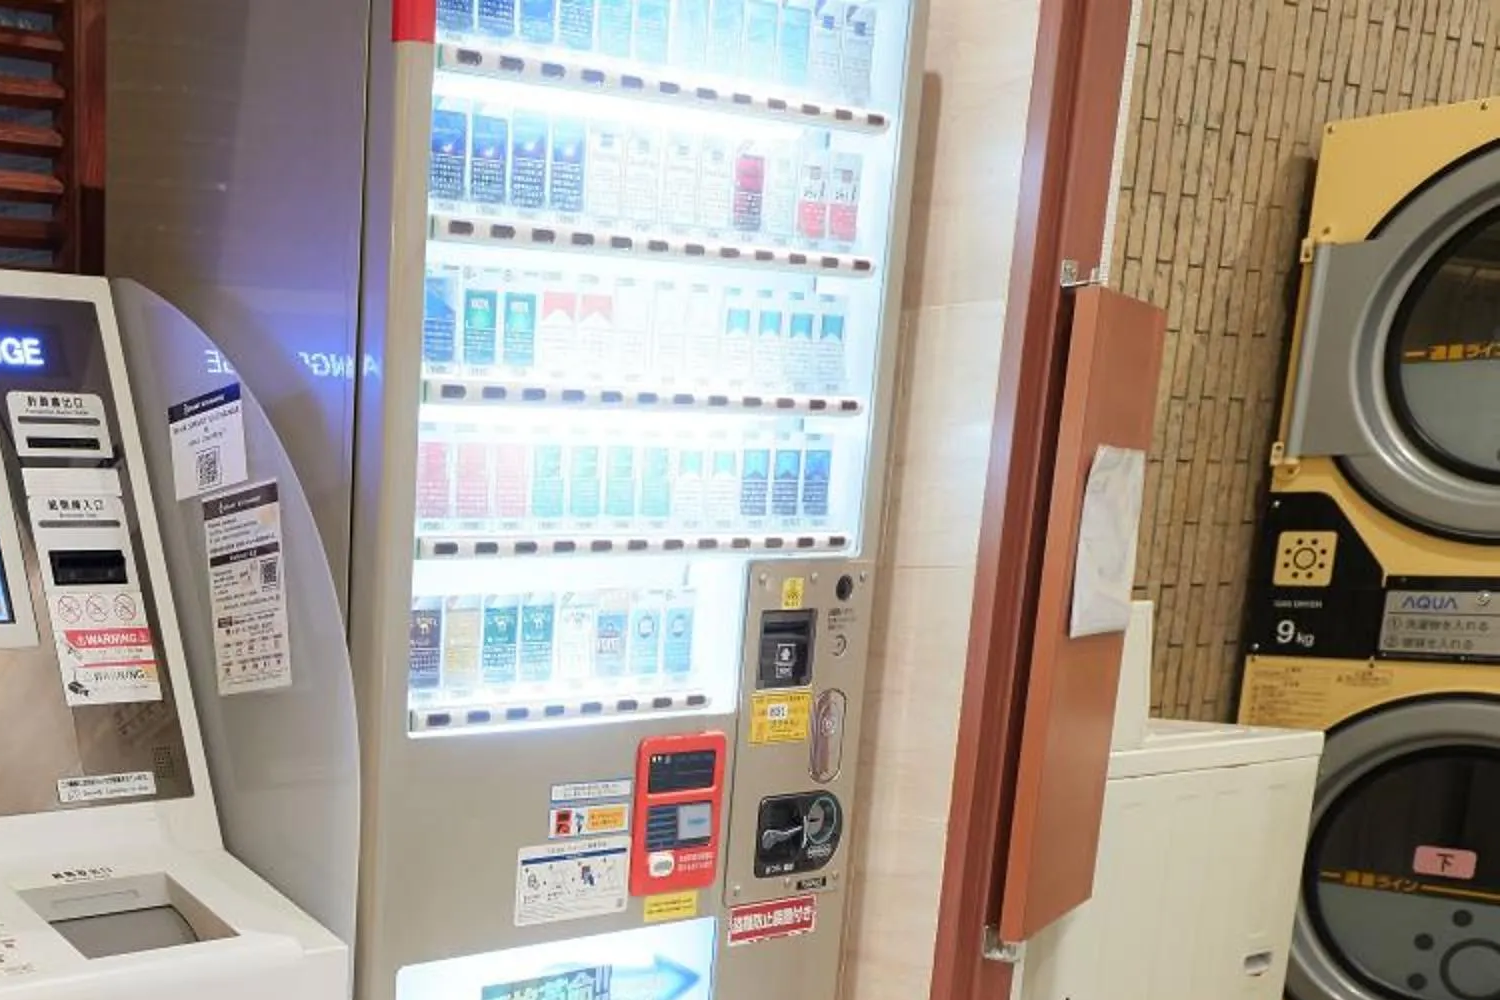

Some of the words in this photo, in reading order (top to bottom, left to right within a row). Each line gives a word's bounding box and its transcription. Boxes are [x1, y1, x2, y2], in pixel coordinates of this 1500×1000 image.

[1402, 595, 1458, 609] AQUA
[85, 633, 137, 645] WARNING
[1276, 619, 1295, 644] 9
[1296, 632, 1315, 647] kg
[1436, 853, 1455, 873] 下
